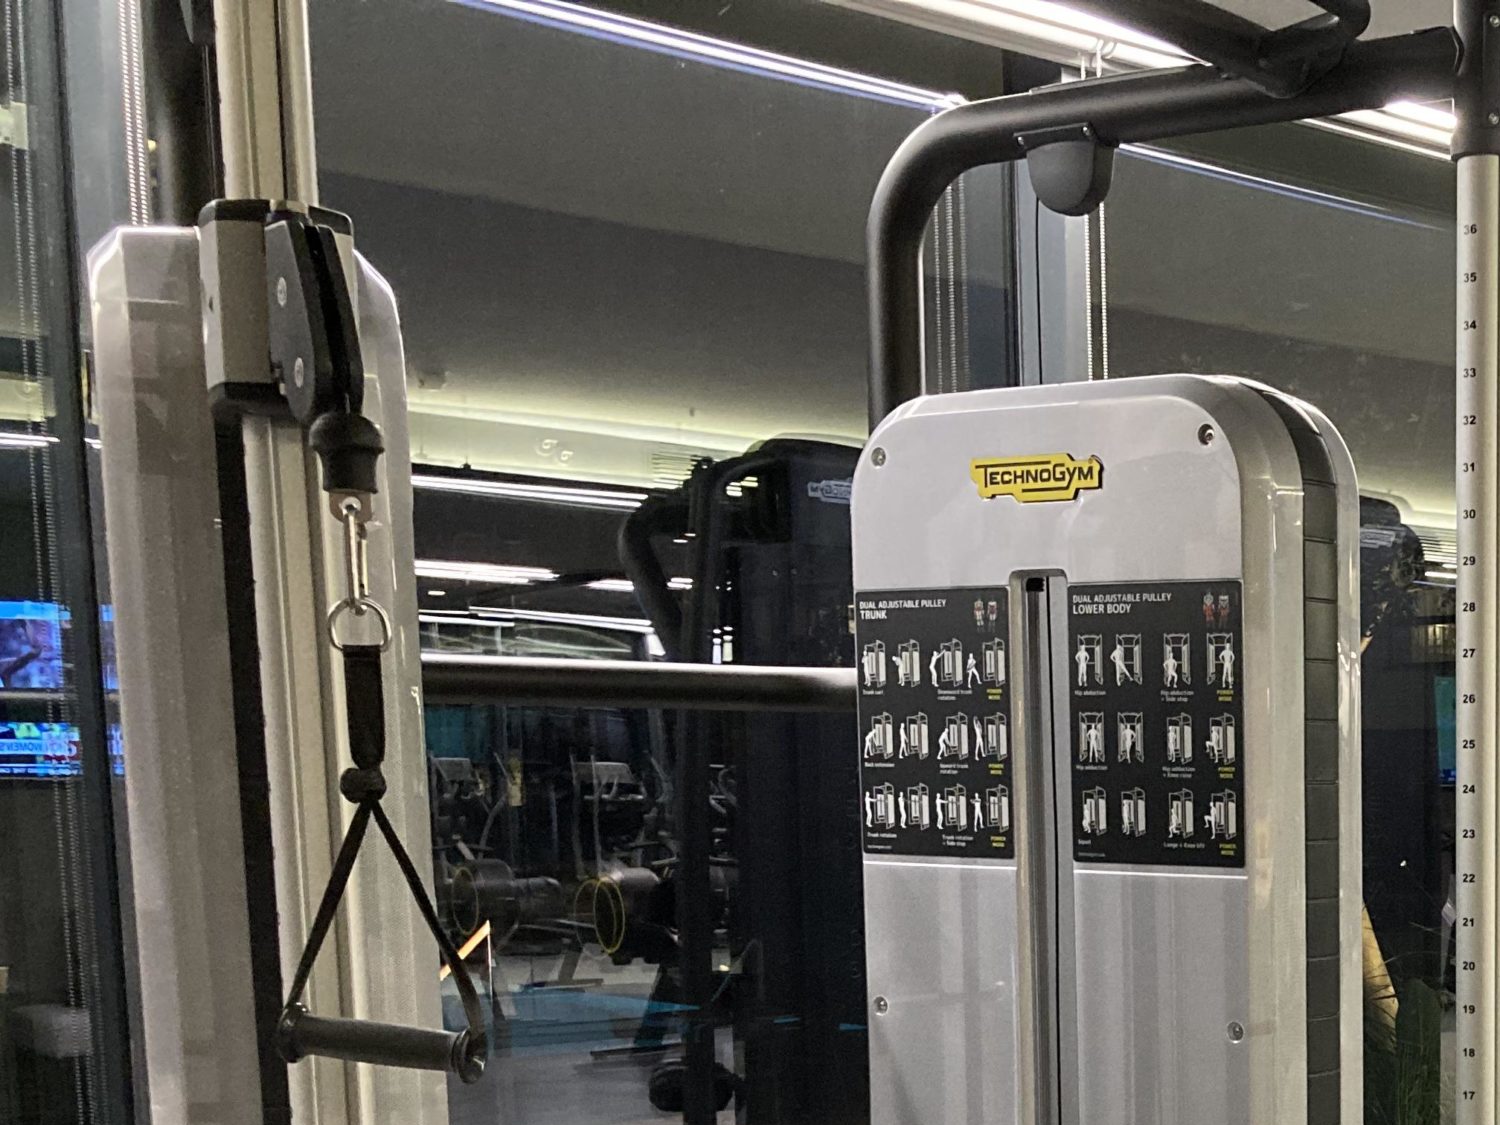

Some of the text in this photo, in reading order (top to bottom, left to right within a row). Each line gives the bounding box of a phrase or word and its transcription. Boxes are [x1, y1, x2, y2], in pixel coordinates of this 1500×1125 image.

[1464, 224, 1477, 235] 36
[1464, 272, 1477, 283] 35
[1464, 320, 1476, 331] 34
[1463, 368, 1476, 378] 33
[1463, 415, 1476, 425] 32
[1463, 462, 1475, 472] 31
[975, 460, 1093, 492] TECHNOGYM
[1463, 509, 1476, 519] 30
[1463, 556, 1476, 566] 29
[1072, 593, 1172, 604] DUAL ADJUSTABLE PULLEY
[860, 599, 947, 609] DUAL ADJUSTABLE PULLEY
[1072, 603, 1132, 615] LOWER BODY
[1462, 602, 1476, 612] 28
[860, 610, 887, 620] TRUNK
[1462, 648, 1476, 658] 27
[1463, 694, 1475, 704] 26
[1462, 739, 1475, 749] 25
[1462, 784, 1475, 794] 24
[1462, 829, 1475, 839] 23
[1462, 873, 1475, 883] 22
[1462, 917, 1474, 927] 21
[1463, 961, 1475, 971] 20
[1463, 1004, 1475, 1014] 19
[1463, 1048, 1475, 1057] 18
[1463, 1090, 1475, 1100] 17
